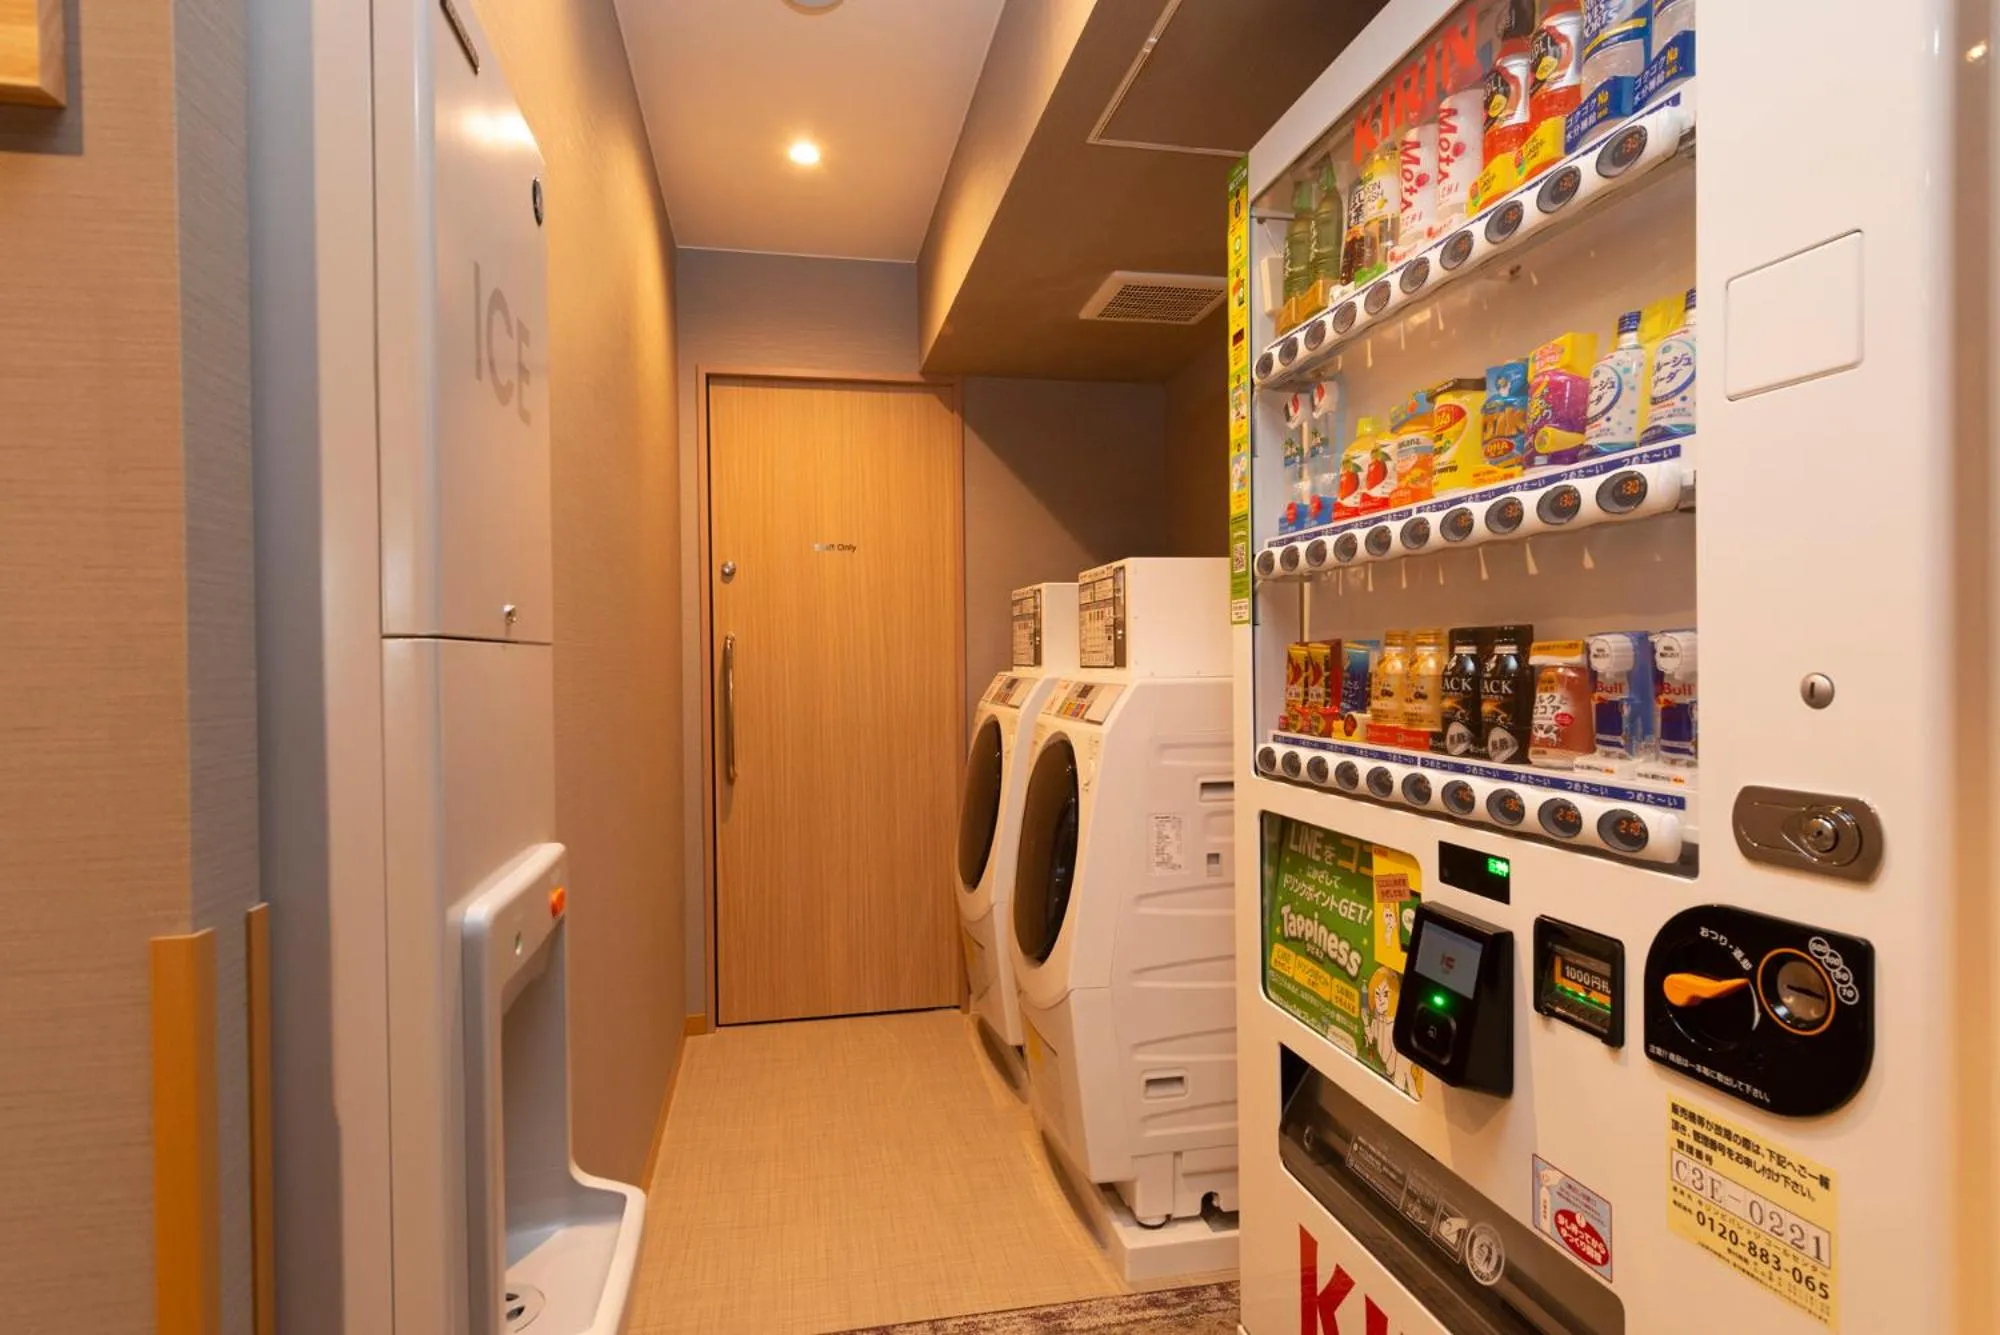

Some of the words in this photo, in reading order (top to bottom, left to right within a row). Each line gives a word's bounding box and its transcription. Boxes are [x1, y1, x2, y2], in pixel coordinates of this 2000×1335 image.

[1353, 6, 1478, 166] KIRIN
[473, 261, 531, 426] ICE
[1281, 903, 1362, 978] Tappiness
[1675, 1158, 1825, 1263] C3E-0221
[1696, 1210, 1830, 1301] 0120-883-065
[1298, 1222, 1389, 1335] K
